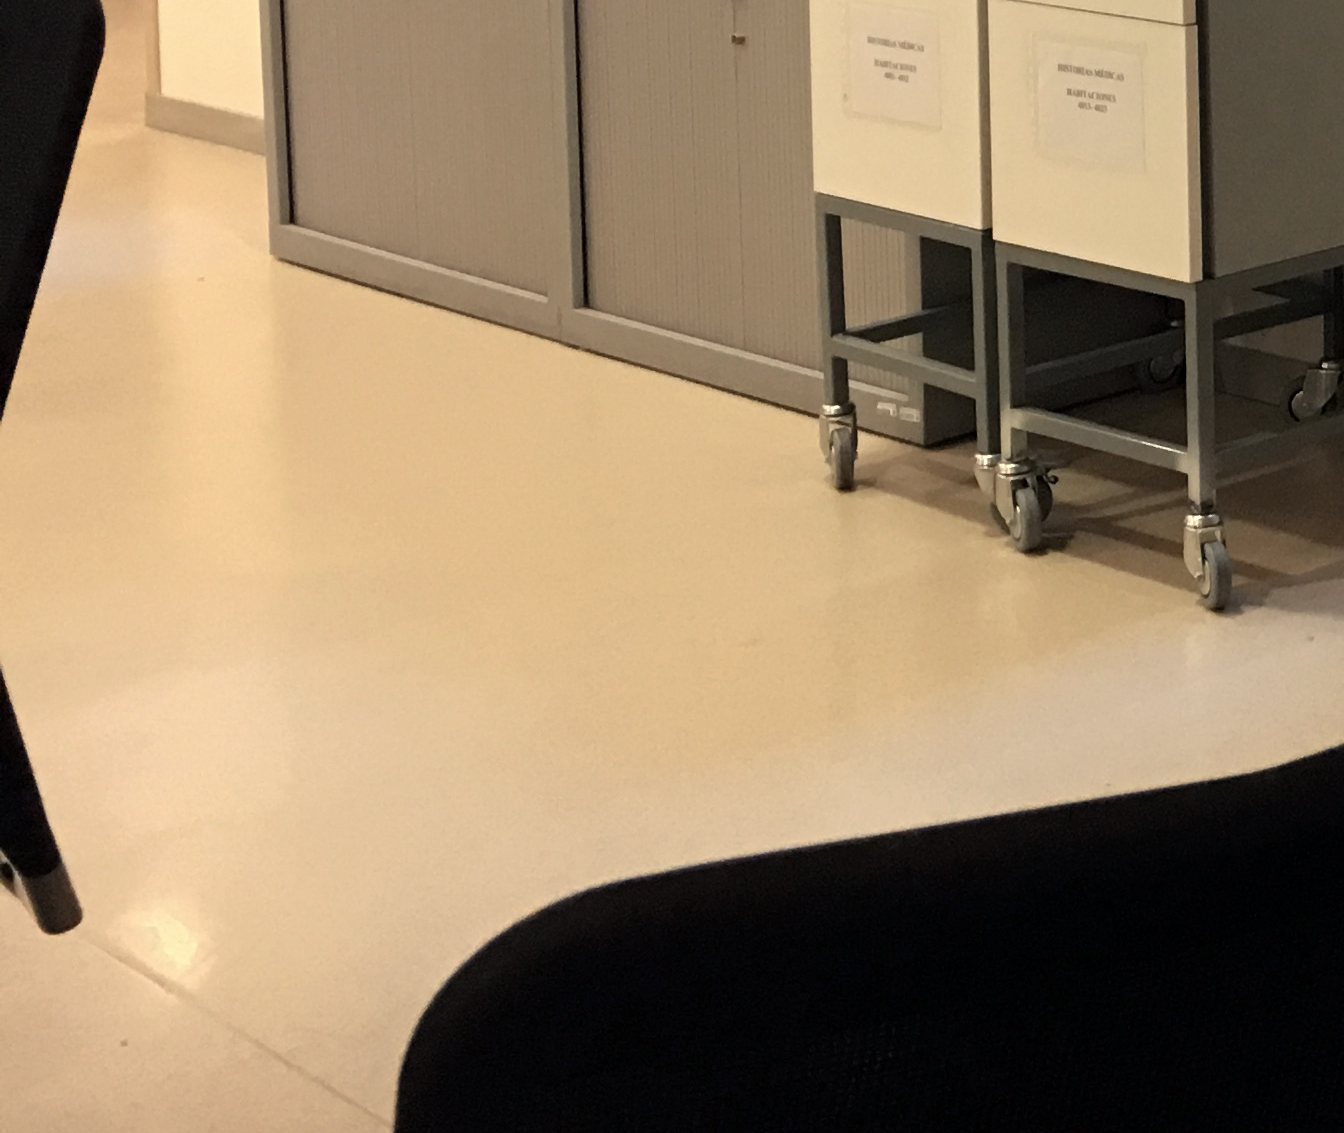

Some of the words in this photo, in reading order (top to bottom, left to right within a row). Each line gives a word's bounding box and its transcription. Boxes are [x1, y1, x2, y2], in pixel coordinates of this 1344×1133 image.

[1057, 63, 1093, 77] HISTORIAS
[1094, 68, 1125, 82] MÉDICAS
[1066, 87, 1117, 104] HABITACIONES
